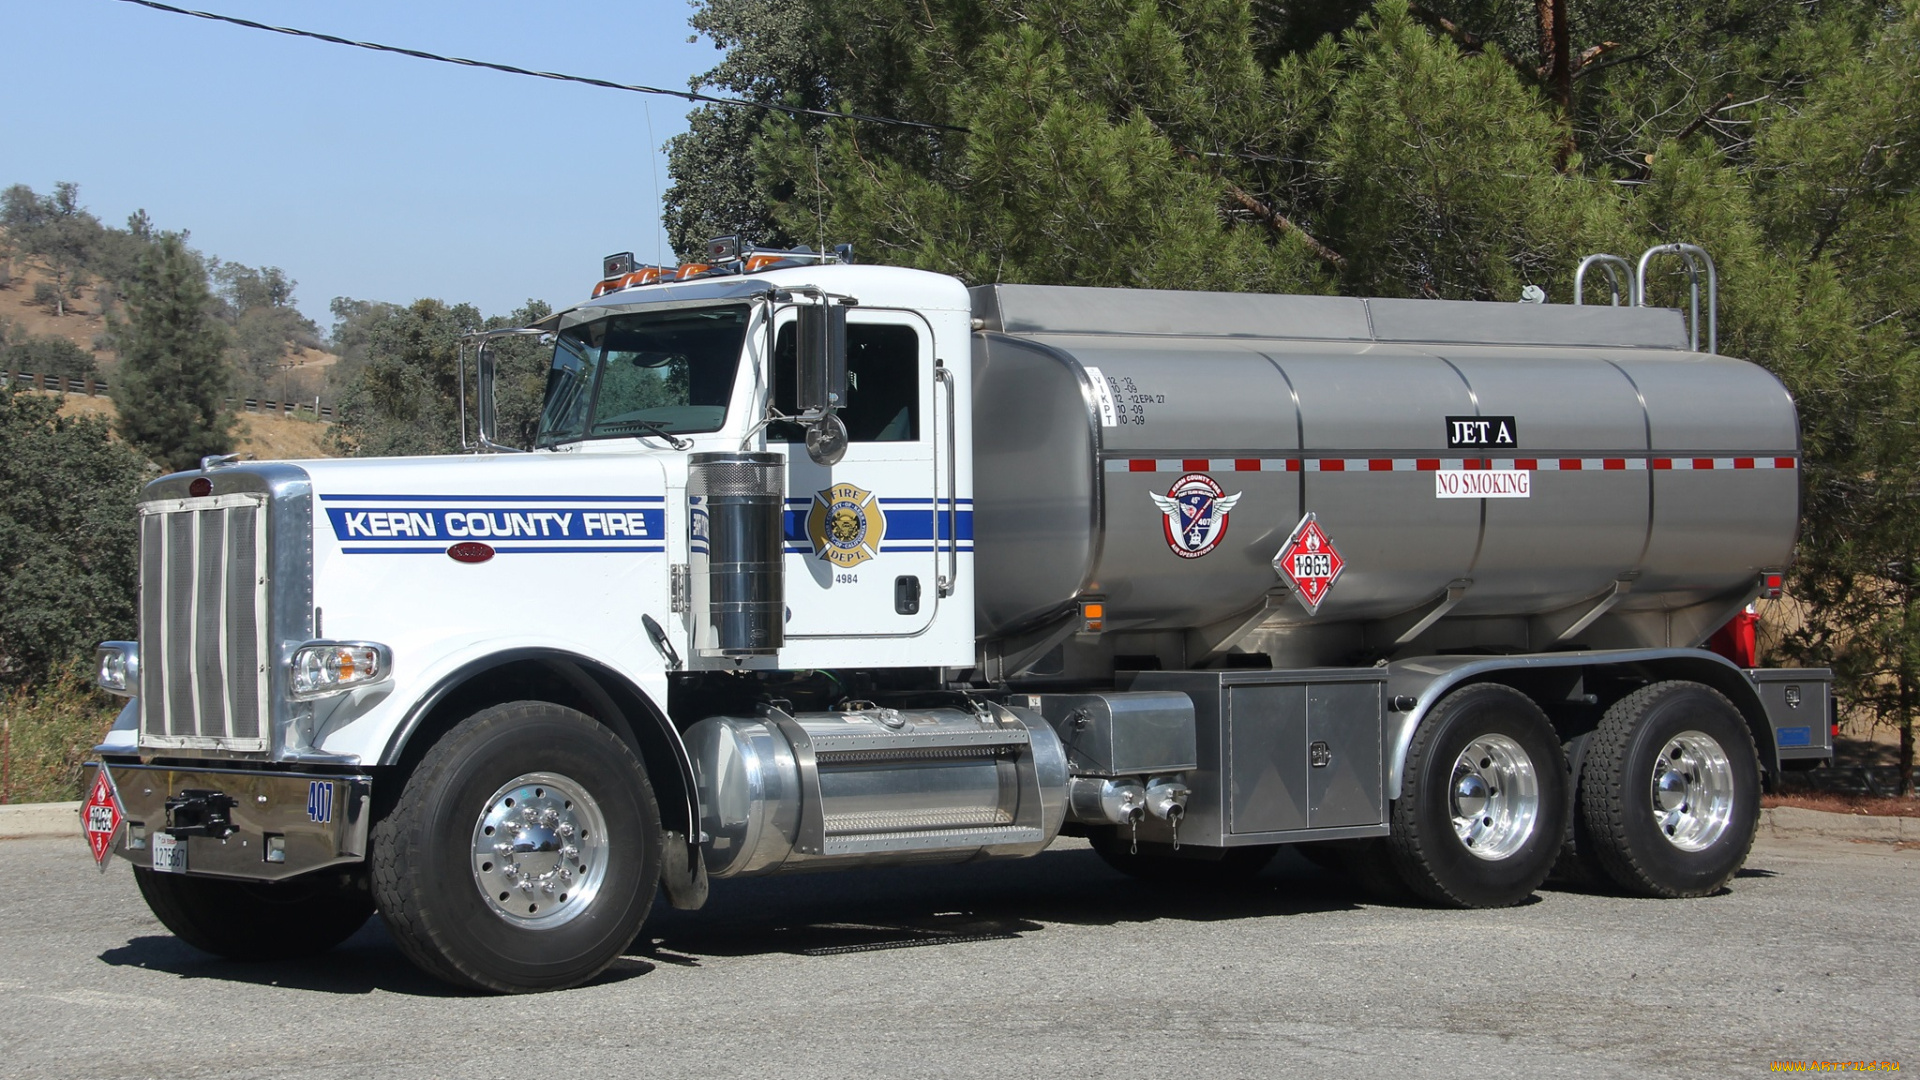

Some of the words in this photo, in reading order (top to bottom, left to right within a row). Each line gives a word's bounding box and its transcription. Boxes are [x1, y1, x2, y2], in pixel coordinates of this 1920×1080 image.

[1111, 385, 1121, 393] 10
[1101, 395, 1109, 403] K
[1114, 394, 1123, 403] 12
[1156, 395, 1165, 403] 27
[1104, 405, 1110, 413] P
[1117, 404, 1126, 414] 10
[1106, 415, 1111, 425] T
[1118, 415, 1128, 425] 10
[1451, 421, 1490, 444] JET
[1495, 420, 1513, 443] A
[1171, 478, 1186, 492] KERN
[1186, 475, 1209, 483] COUNTY
[1209, 479, 1221, 494] FIRE
[1438, 473, 1459, 494] NO
[1462, 473, 1528, 494] SMOKING
[830, 488, 861, 500] FIRE
[344, 511, 437, 536] KERN
[444, 512, 573, 537] COUNTY
[582, 512, 649, 536] FIRE
[1197, 518, 1211, 526] 407
[830, 550, 864, 562] DEPT.
[1170, 544, 1179, 553] AIR
[1179, 544, 1215, 557] OPERATIONS
[1296, 555, 1330, 576] 1863
[835, 573, 858, 584] 4984
[1309, 581, 1318, 596] 3
[307, 781, 333, 823] 407
